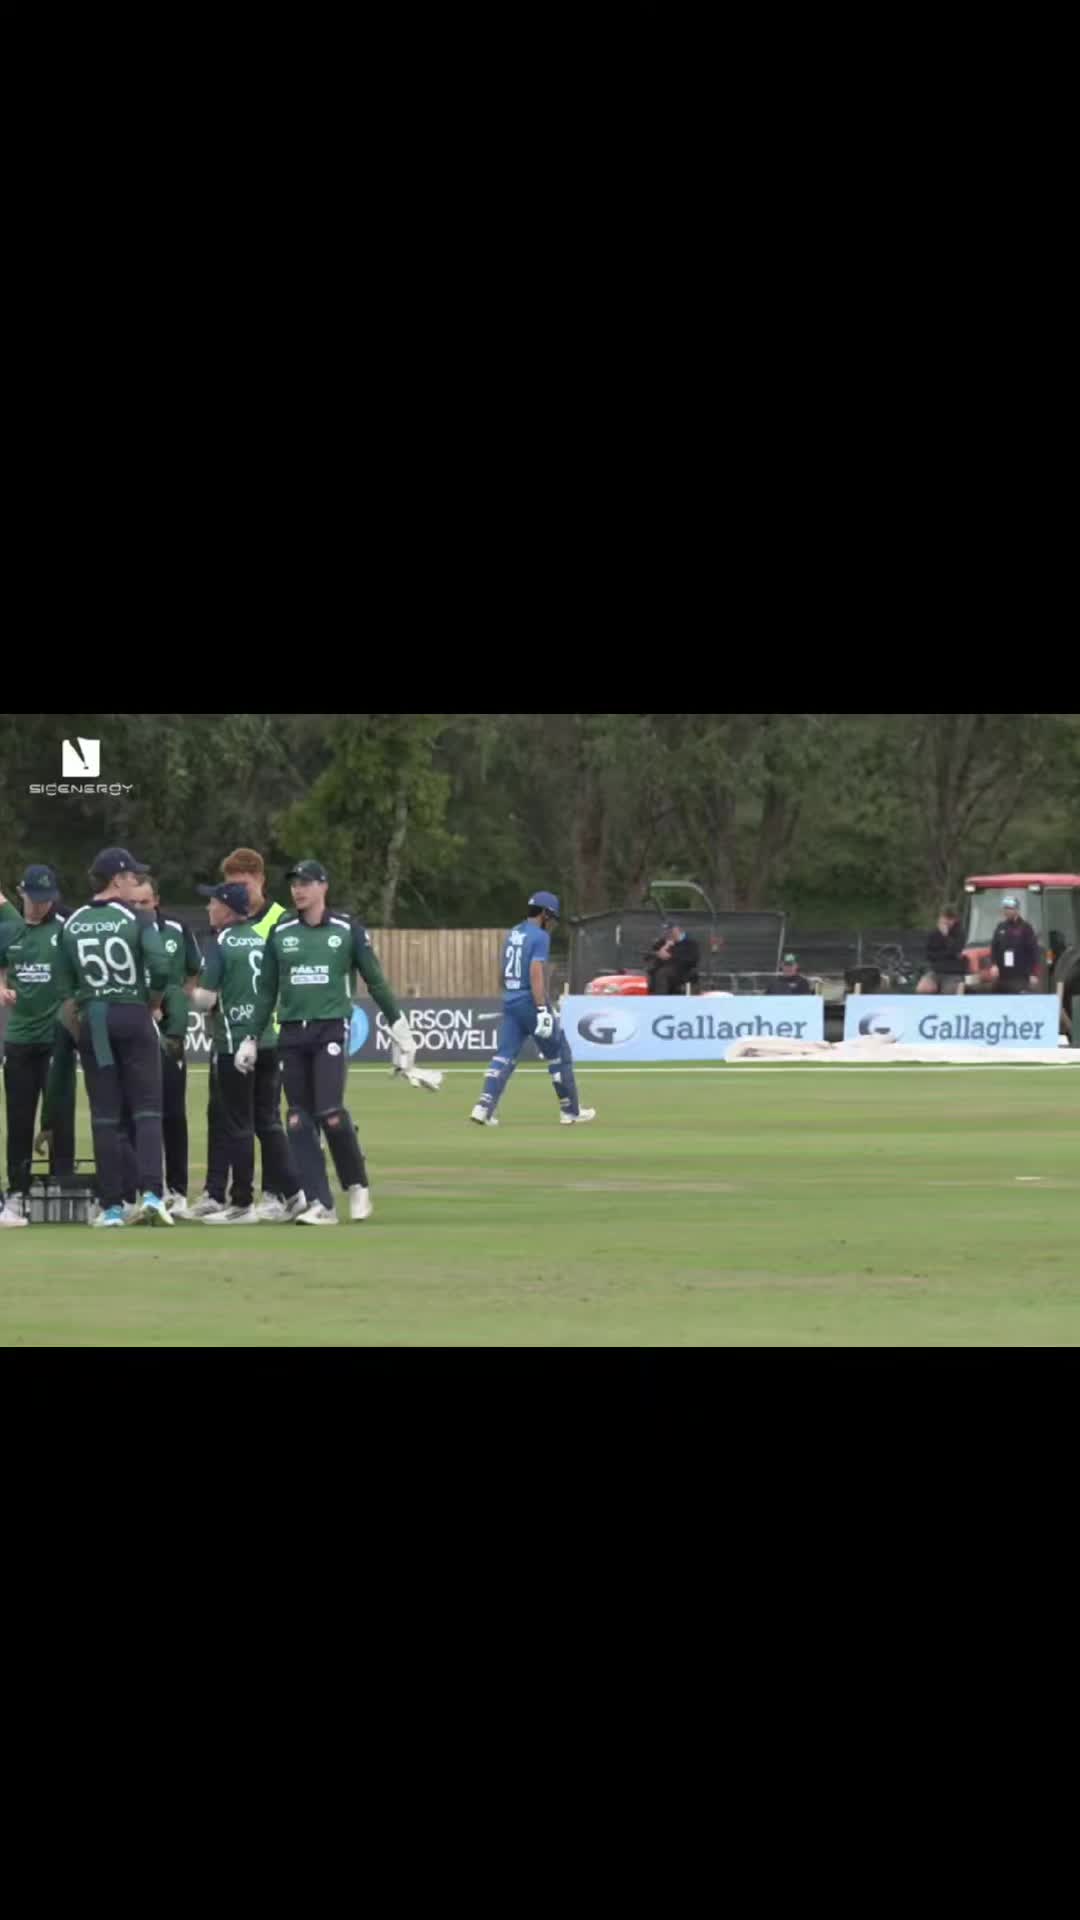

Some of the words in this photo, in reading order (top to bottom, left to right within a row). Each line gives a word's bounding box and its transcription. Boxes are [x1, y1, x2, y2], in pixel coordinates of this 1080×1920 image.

[69, 921, 122, 935] Carpay
[77, 936, 137, 988] 59
[651, 1014, 807, 1040] Gallagher
[918, 1014, 1045, 1046] Gallagher
[375, 1030, 498, 1051] MDOWELL
